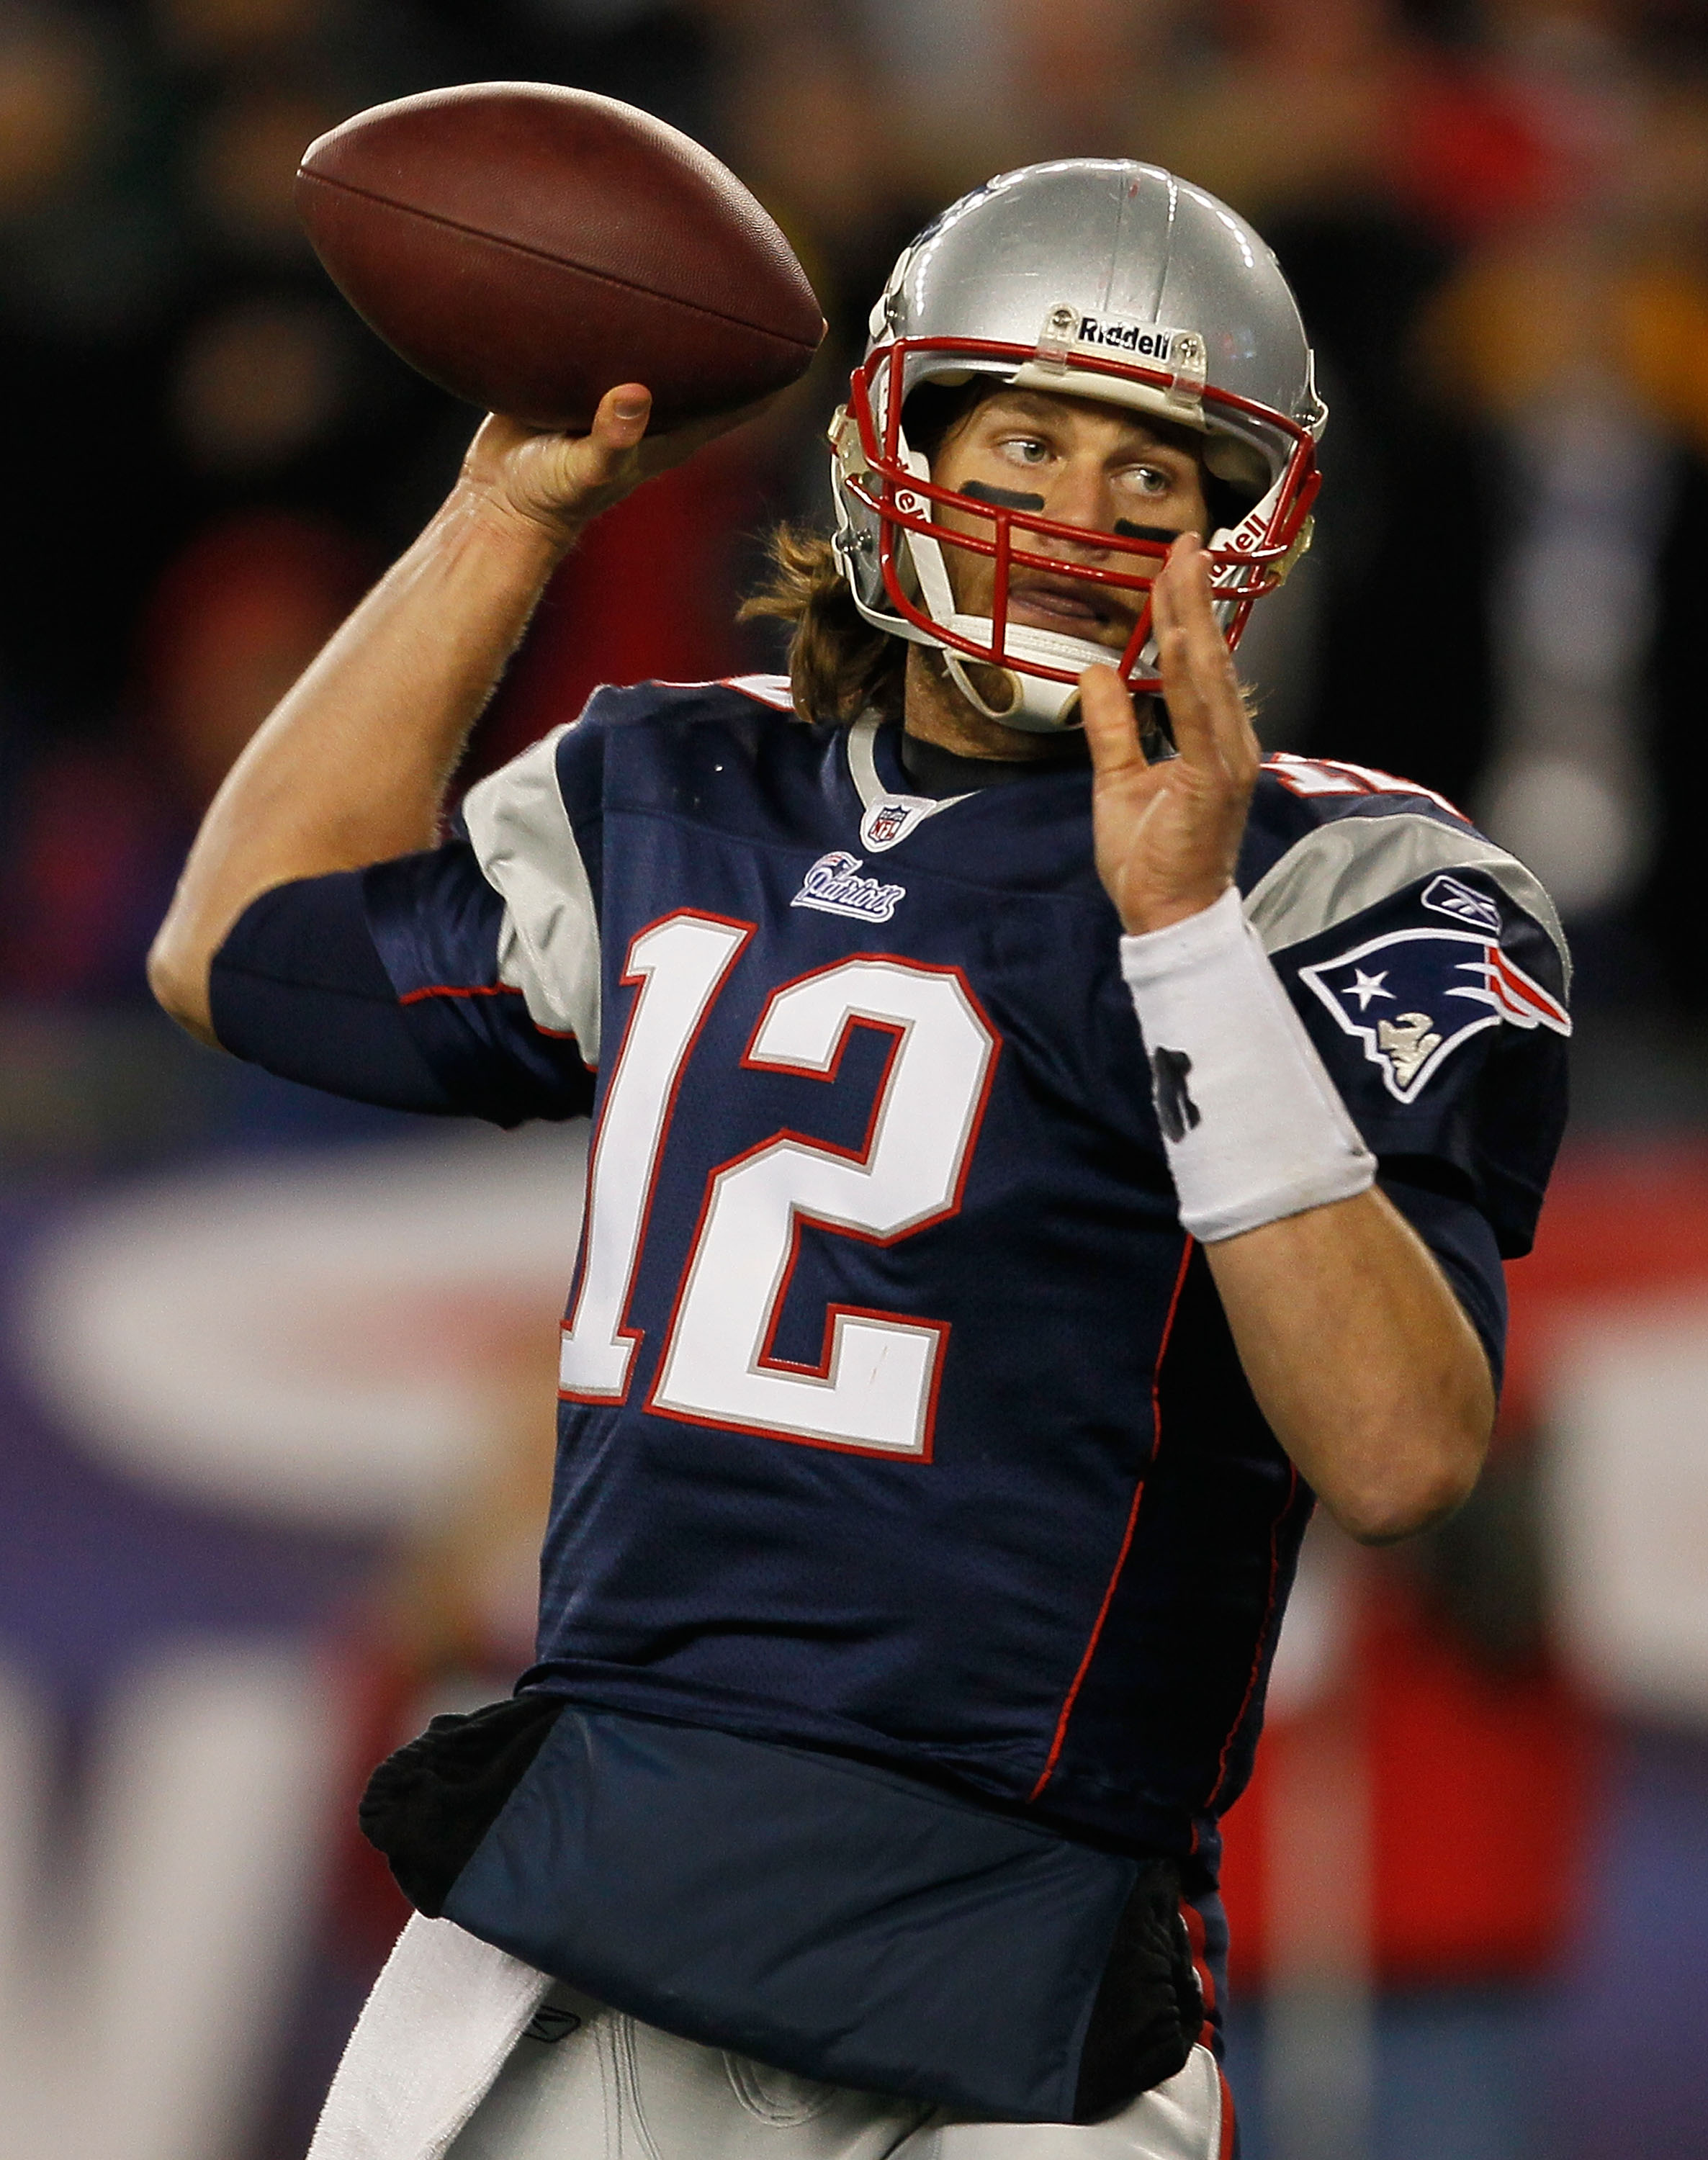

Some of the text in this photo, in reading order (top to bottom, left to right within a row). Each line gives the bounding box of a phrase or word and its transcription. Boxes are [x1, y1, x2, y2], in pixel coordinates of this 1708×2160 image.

[1078, 318, 1170, 360] Riddell
[792, 864, 905, 918] Patriots
[557, 906, 1003, 1464] 12
